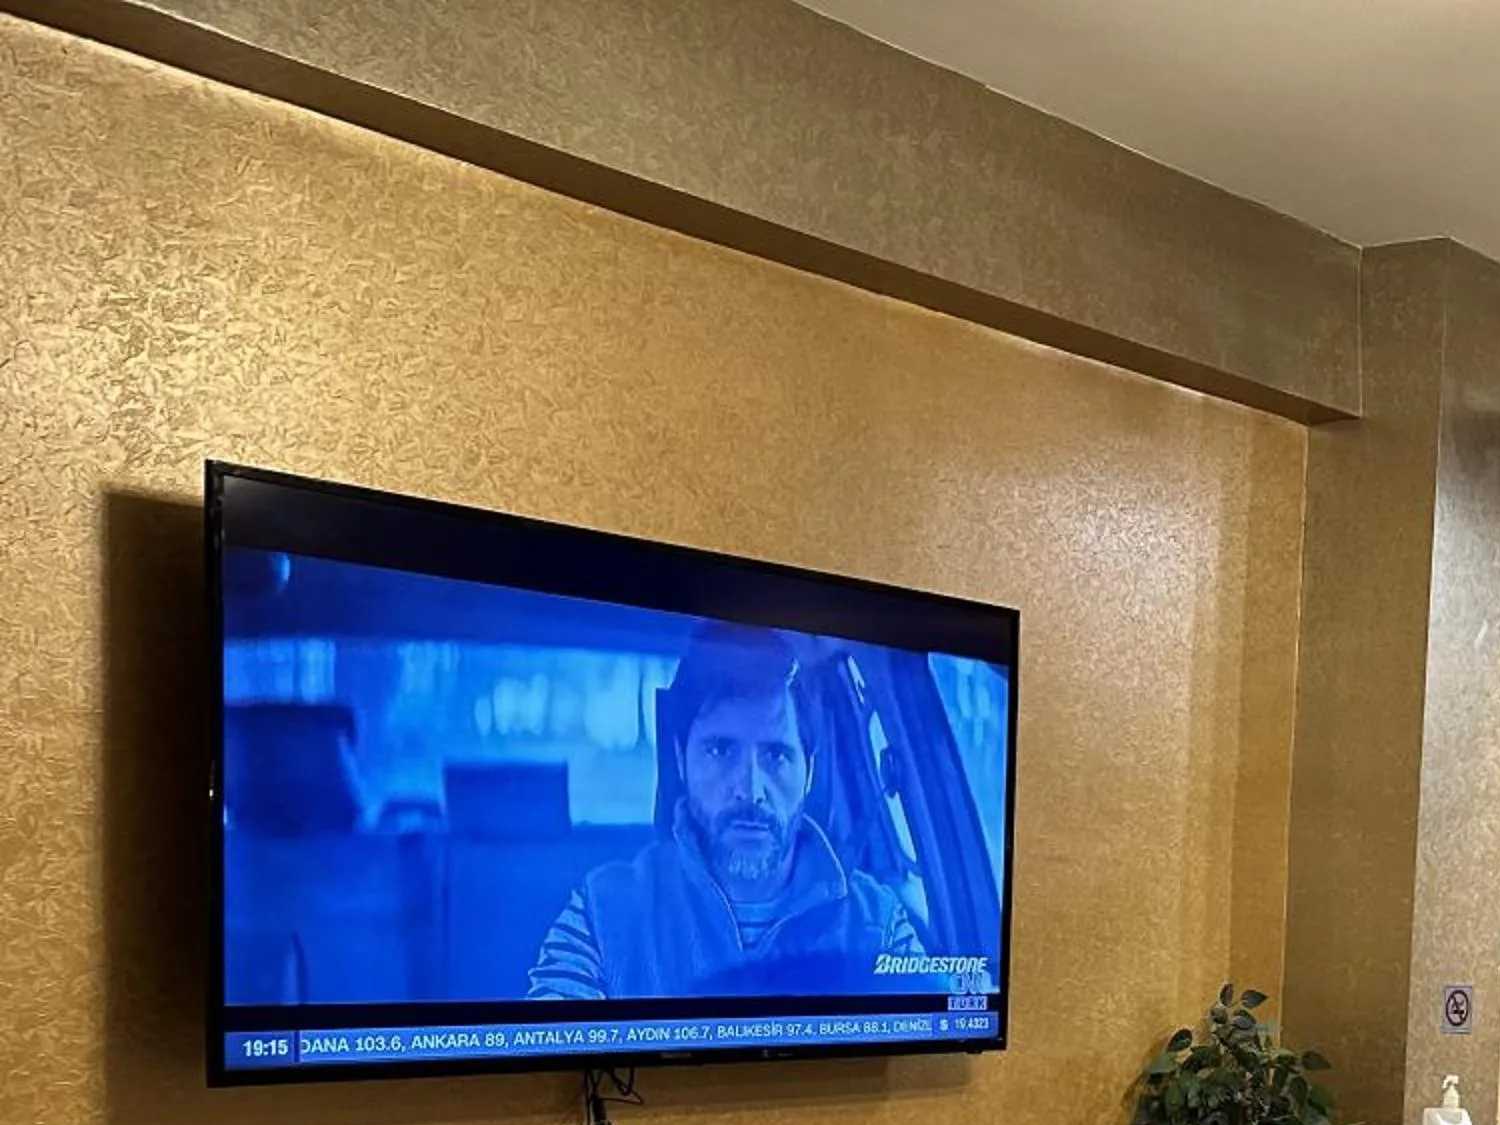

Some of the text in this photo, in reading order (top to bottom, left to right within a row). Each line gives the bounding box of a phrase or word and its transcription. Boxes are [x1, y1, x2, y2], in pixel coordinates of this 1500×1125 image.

[874, 954, 988, 974] BRIDGESTONE
[355, 1035, 406, 1052] 103.6,
[411, 1033, 480, 1049] ANKARA
[485, 1032, 509, 1049] 89,
[513, 1030, 584, 1046] ANTALYA
[588, 1028, 623, 1044] 99.7,
[626, 1026, 671, 1042] AYDIN
[673, 1026, 713, 1041] 106.7,
[819, 1022, 860, 1036] BURSA
[242, 1039, 288, 1057] 19:15
